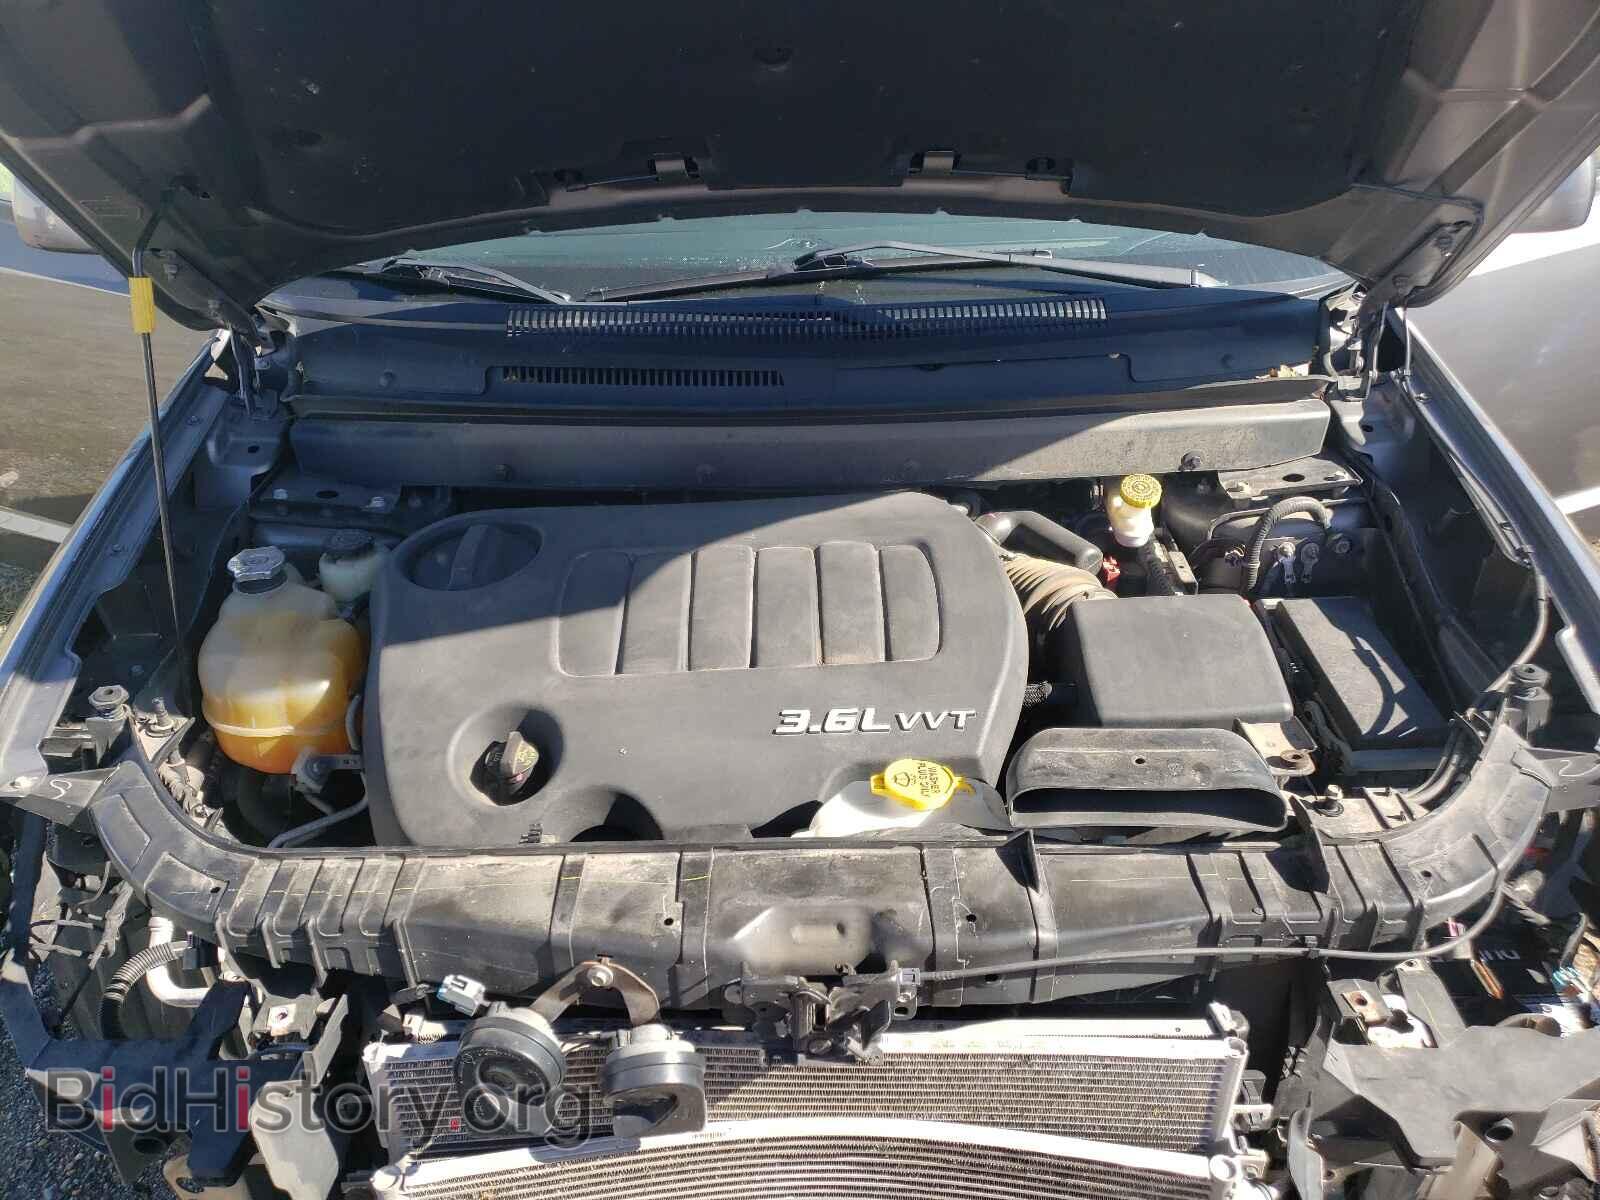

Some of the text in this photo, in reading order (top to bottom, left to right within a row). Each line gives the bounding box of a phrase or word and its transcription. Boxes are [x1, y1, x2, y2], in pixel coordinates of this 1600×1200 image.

[772, 708, 977, 735] 3.6L VVT
[917, 762, 930, 798] FLUID ONLY
[929, 766, 941, 794] WASHER
